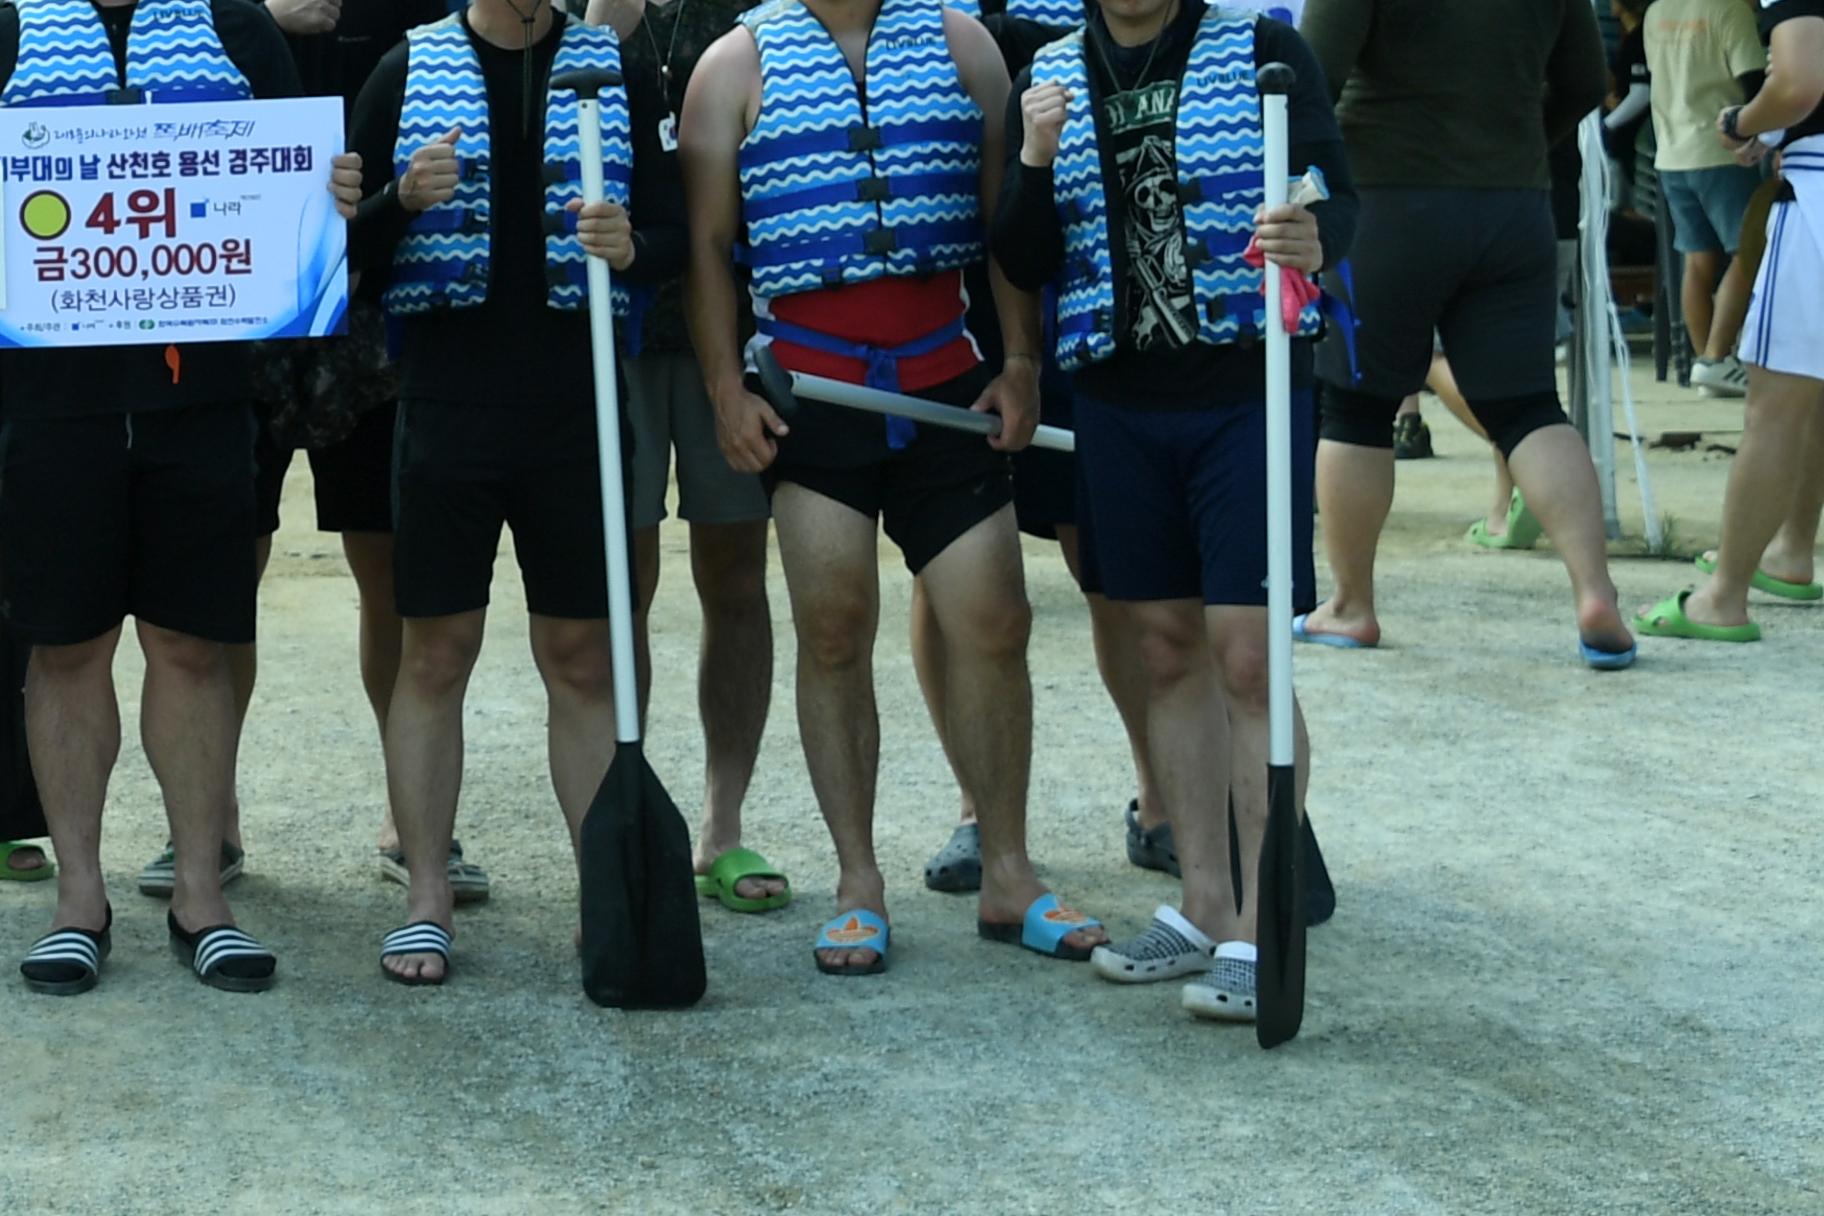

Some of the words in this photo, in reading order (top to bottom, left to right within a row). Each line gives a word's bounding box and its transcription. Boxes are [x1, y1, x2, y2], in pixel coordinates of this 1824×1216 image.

[79, 153, 102, 181] 날
[106, 150, 172, 179] 산천호
[177, 149, 221, 177] 용선
[227, 144, 314, 175] 경주대회
[84, 186, 177, 240] 4위
[212, 201, 243, 217] 나라
[32, 237, 253, 283] 금300,000원
[50, 283, 237, 314] (화천사랑상품권)
